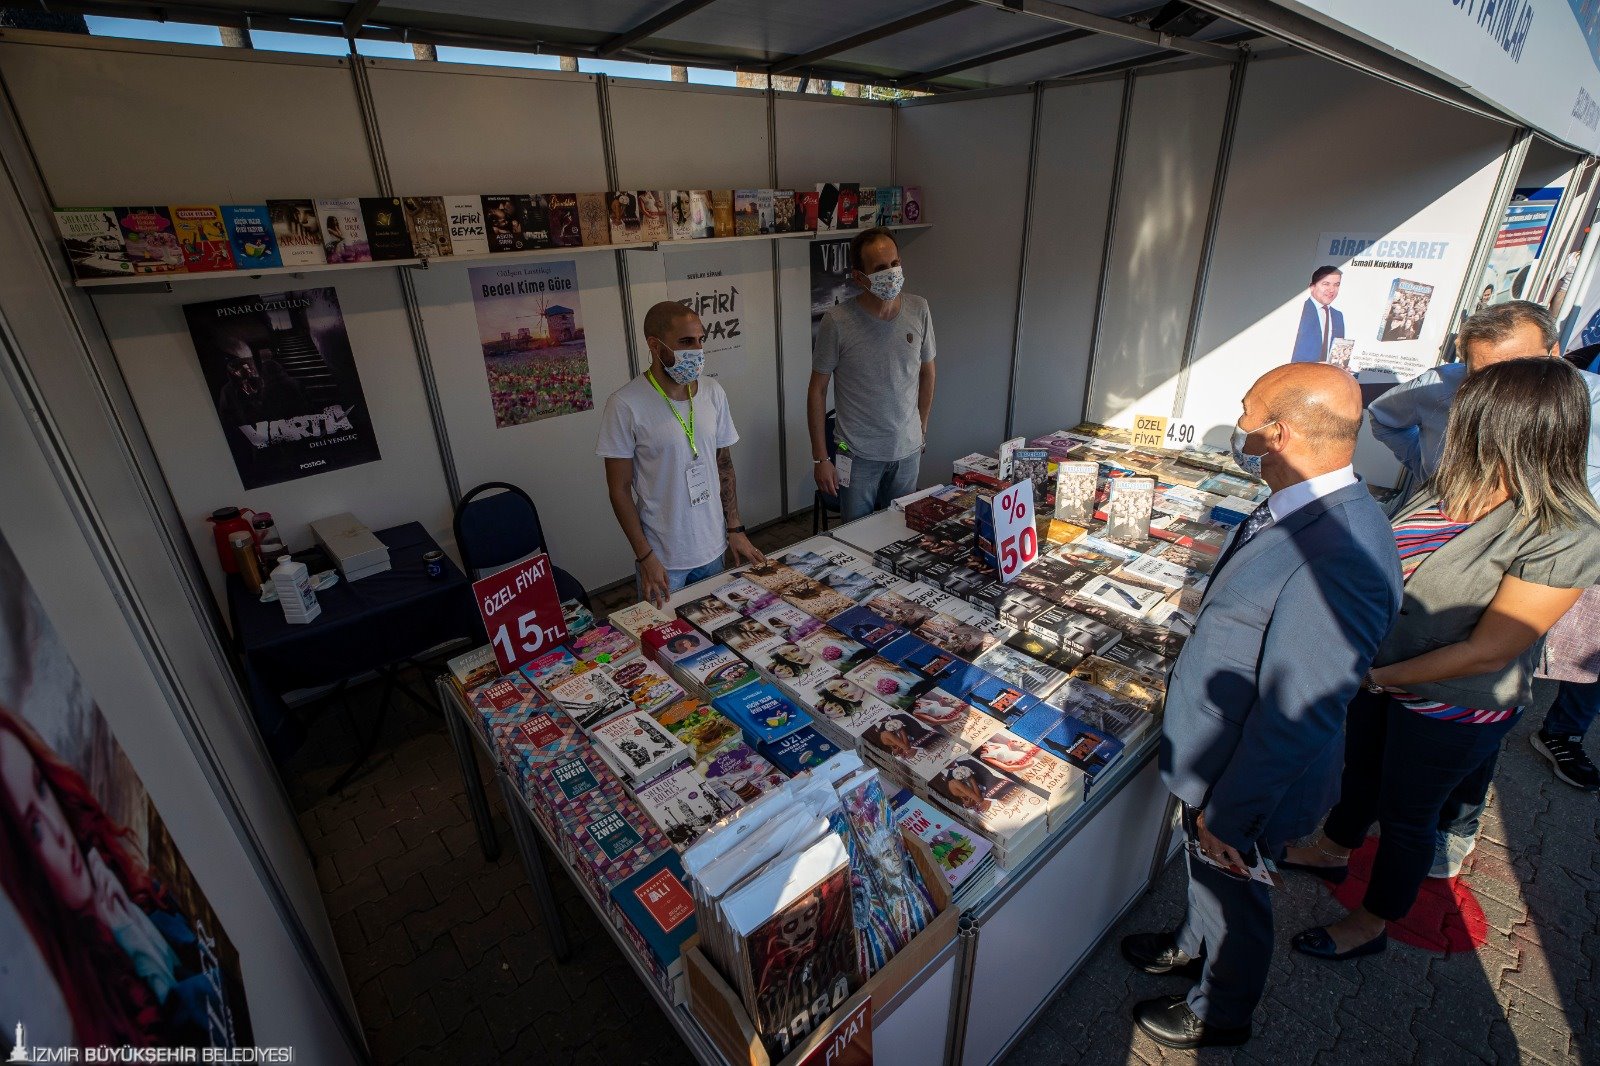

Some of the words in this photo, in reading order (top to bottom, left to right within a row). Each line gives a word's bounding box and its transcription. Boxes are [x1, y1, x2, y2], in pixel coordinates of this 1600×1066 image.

[61, 214, 100, 224] SHERLOCK
[69, 222, 100, 233] HOLMES
[451, 226, 484, 237] BEYAZ
[1329, 236, 1374, 256] BİRAZ
[1376, 239, 1449, 260] CESARET
[1351, 259, 1374, 268] İsmail
[1374, 259, 1413, 269] Küçükkaya
[482, 281, 516, 298] Bedel
[517, 279, 545, 295] Kime
[548, 277, 572, 291] Göre
[217, 305, 253, 318] PINAR
[701, 318, 741, 343] YAZ
[1137, 416, 1163, 431] ÖZEL
[1134, 431, 1162, 445] FİYAT
[1167, 422, 1195, 444] 4.90
[1002, 489, 1026, 525] %
[1001, 526, 1037, 575] 50
[484, 585, 517, 617] ÖZEL
[515, 559, 546, 594] FİYAT
[484, 681, 511, 697] STEFAN
[488, 685, 514, 700] ZWEIG
[523, 714, 548, 731] STEFAN
[526, 719, 553, 736] ZWEIG
[555, 760, 582, 776] STEFAN
[558, 765, 586, 783] ZWEIG
[643, 776, 678, 800] SHERLOCK
[652, 786, 680, 808] HOLMES
[590, 813, 618, 832] STEFAN
[594, 819, 625, 841] ZWEIG
[825, 1007, 867, 1066] FİYAT
